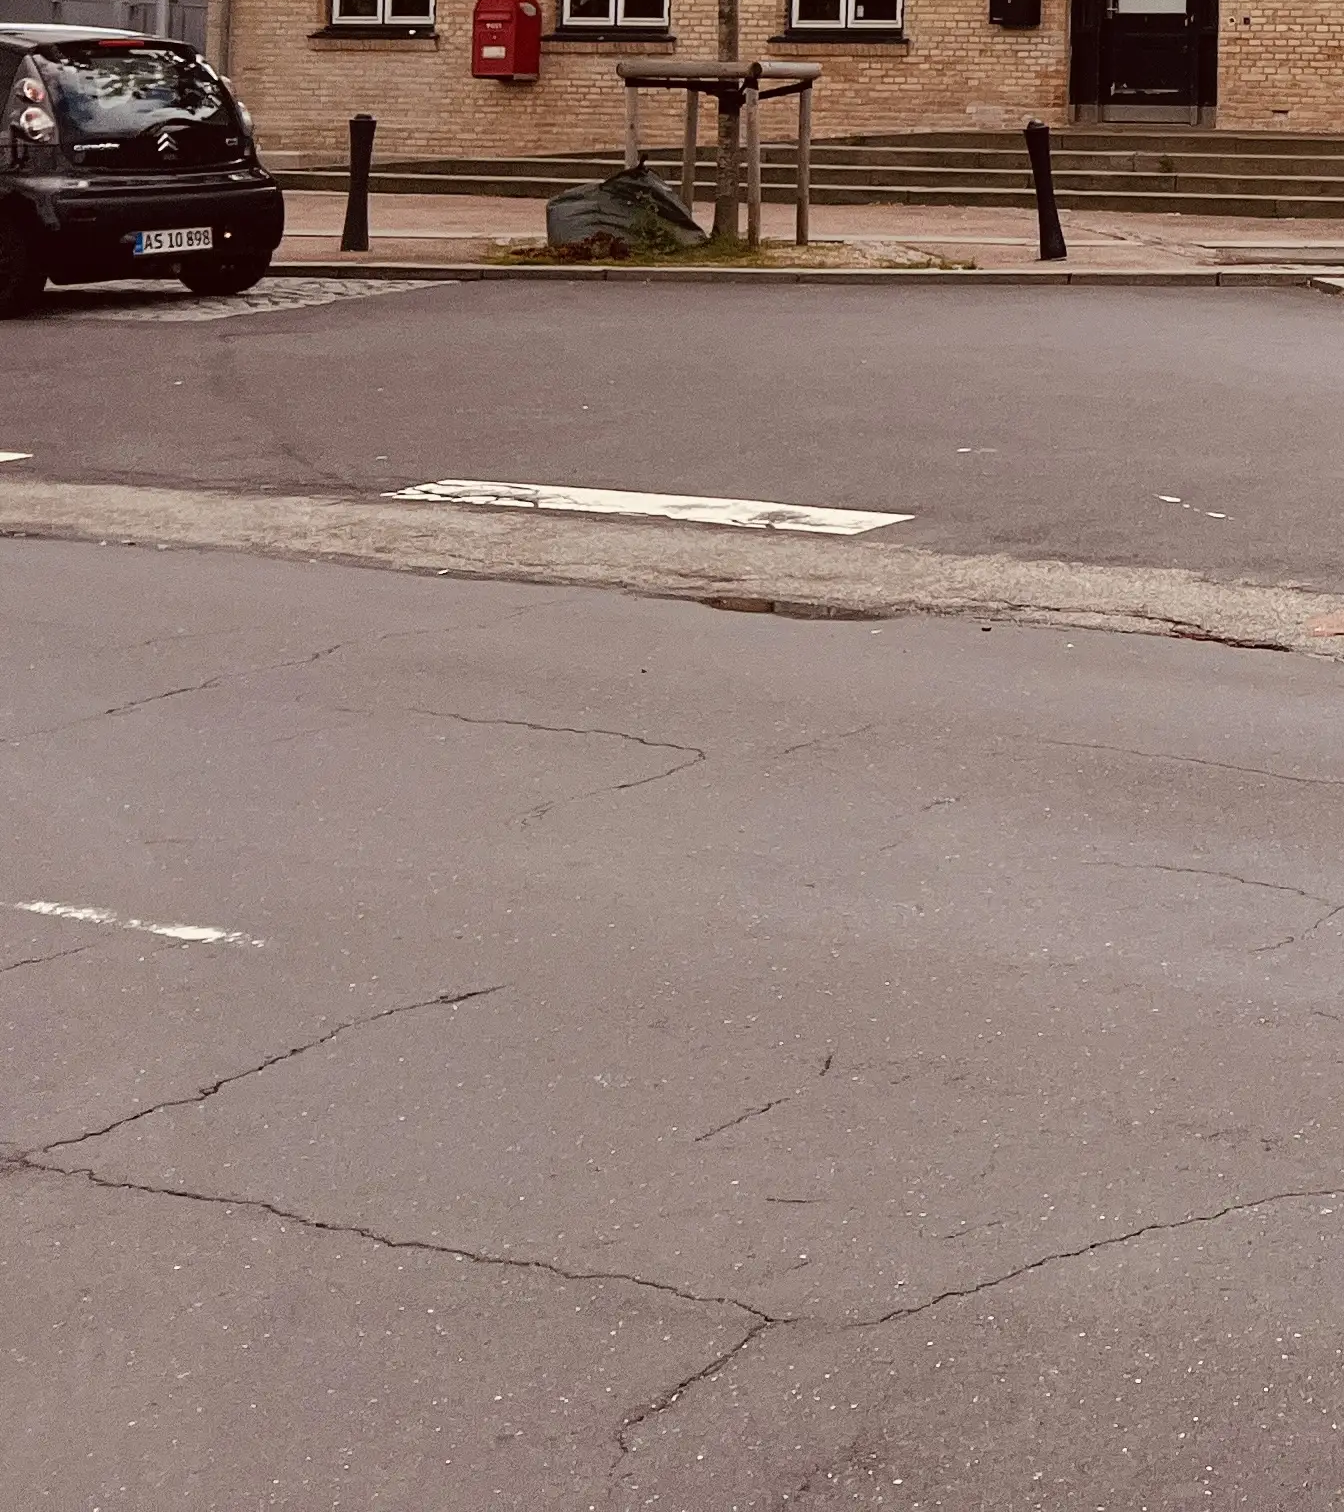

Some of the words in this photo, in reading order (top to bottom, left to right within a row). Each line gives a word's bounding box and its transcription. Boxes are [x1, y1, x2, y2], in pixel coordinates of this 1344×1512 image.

[144, 234, 163, 250] AS
[168, 232, 183, 249] 10
[186, 230, 211, 247] 898
